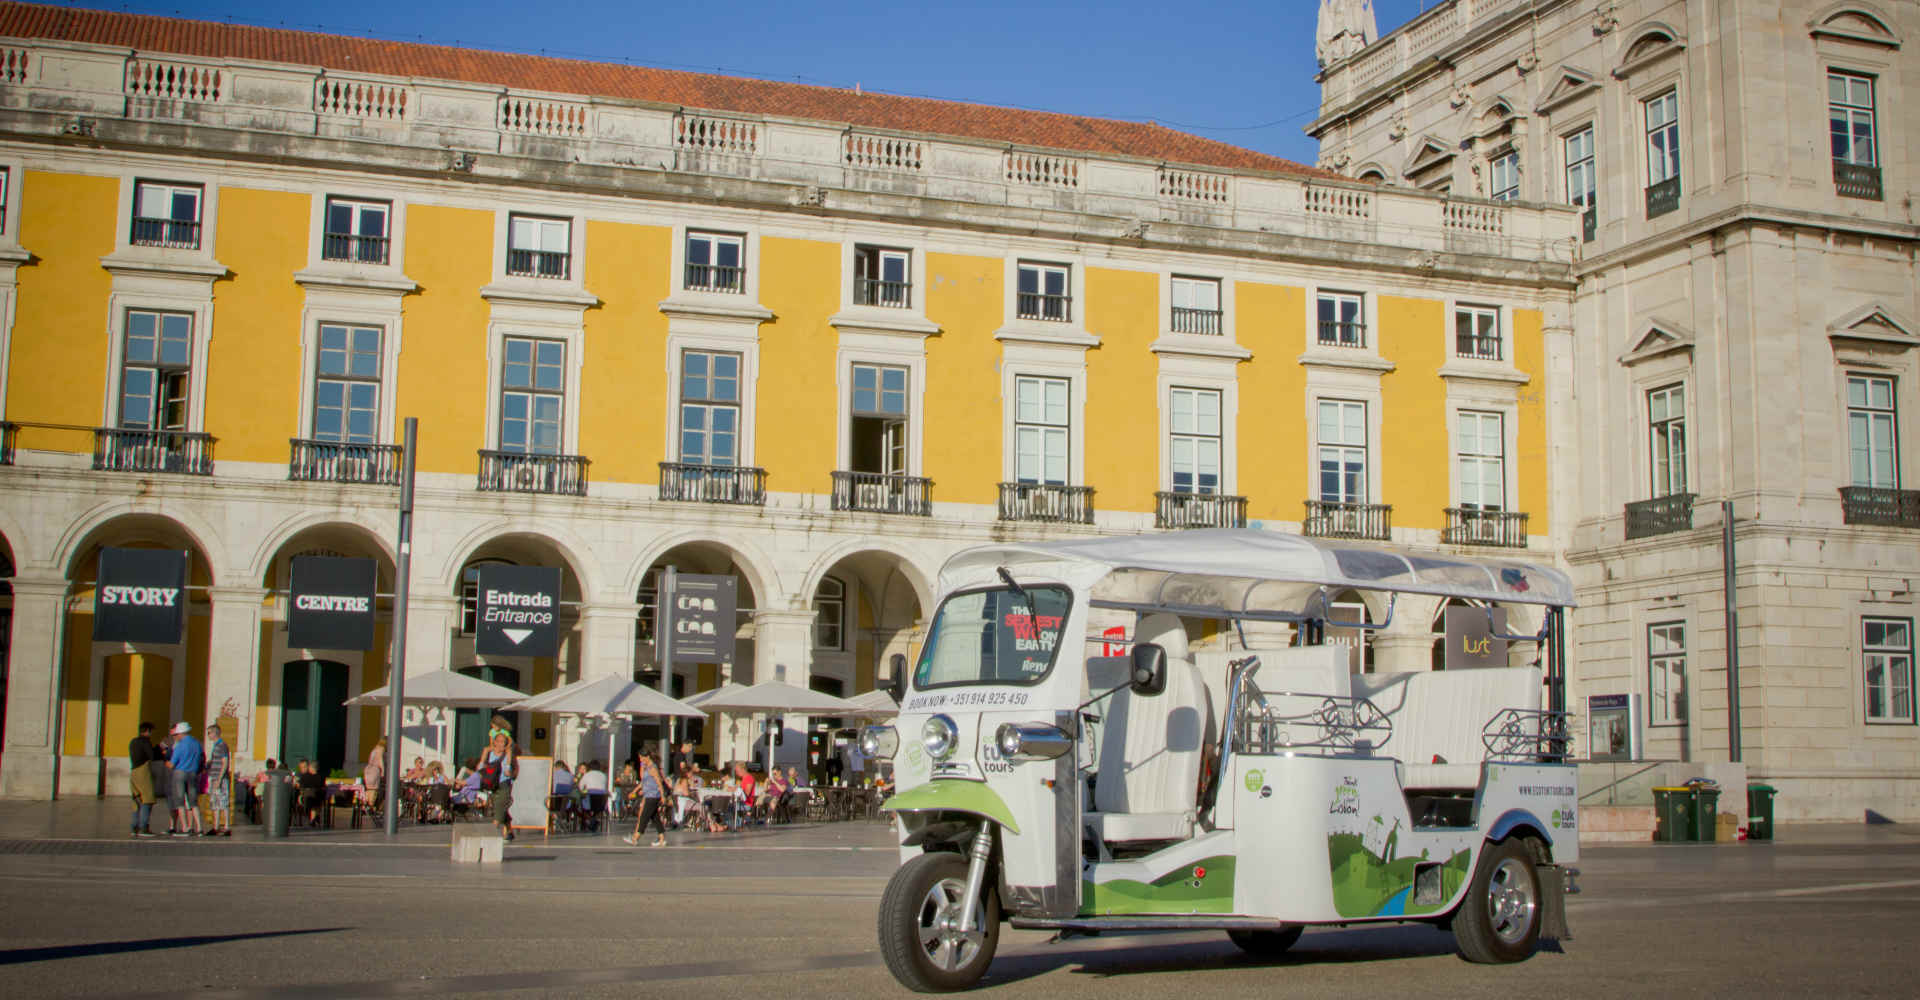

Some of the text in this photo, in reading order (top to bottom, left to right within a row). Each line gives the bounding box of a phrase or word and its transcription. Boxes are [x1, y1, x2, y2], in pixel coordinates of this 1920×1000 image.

[102, 585, 179, 607] STORY
[296, 594, 369, 612] CENTRE
[486, 590, 552, 607] Entrada
[485, 607, 552, 624] Entrance
[1463, 634, 1491, 654] lust
[971, 692, 985, 705] 914
[987, 691, 1006, 704] 925
[1008, 691, 1028, 705] 450
[984, 761, 1014, 773] tours
